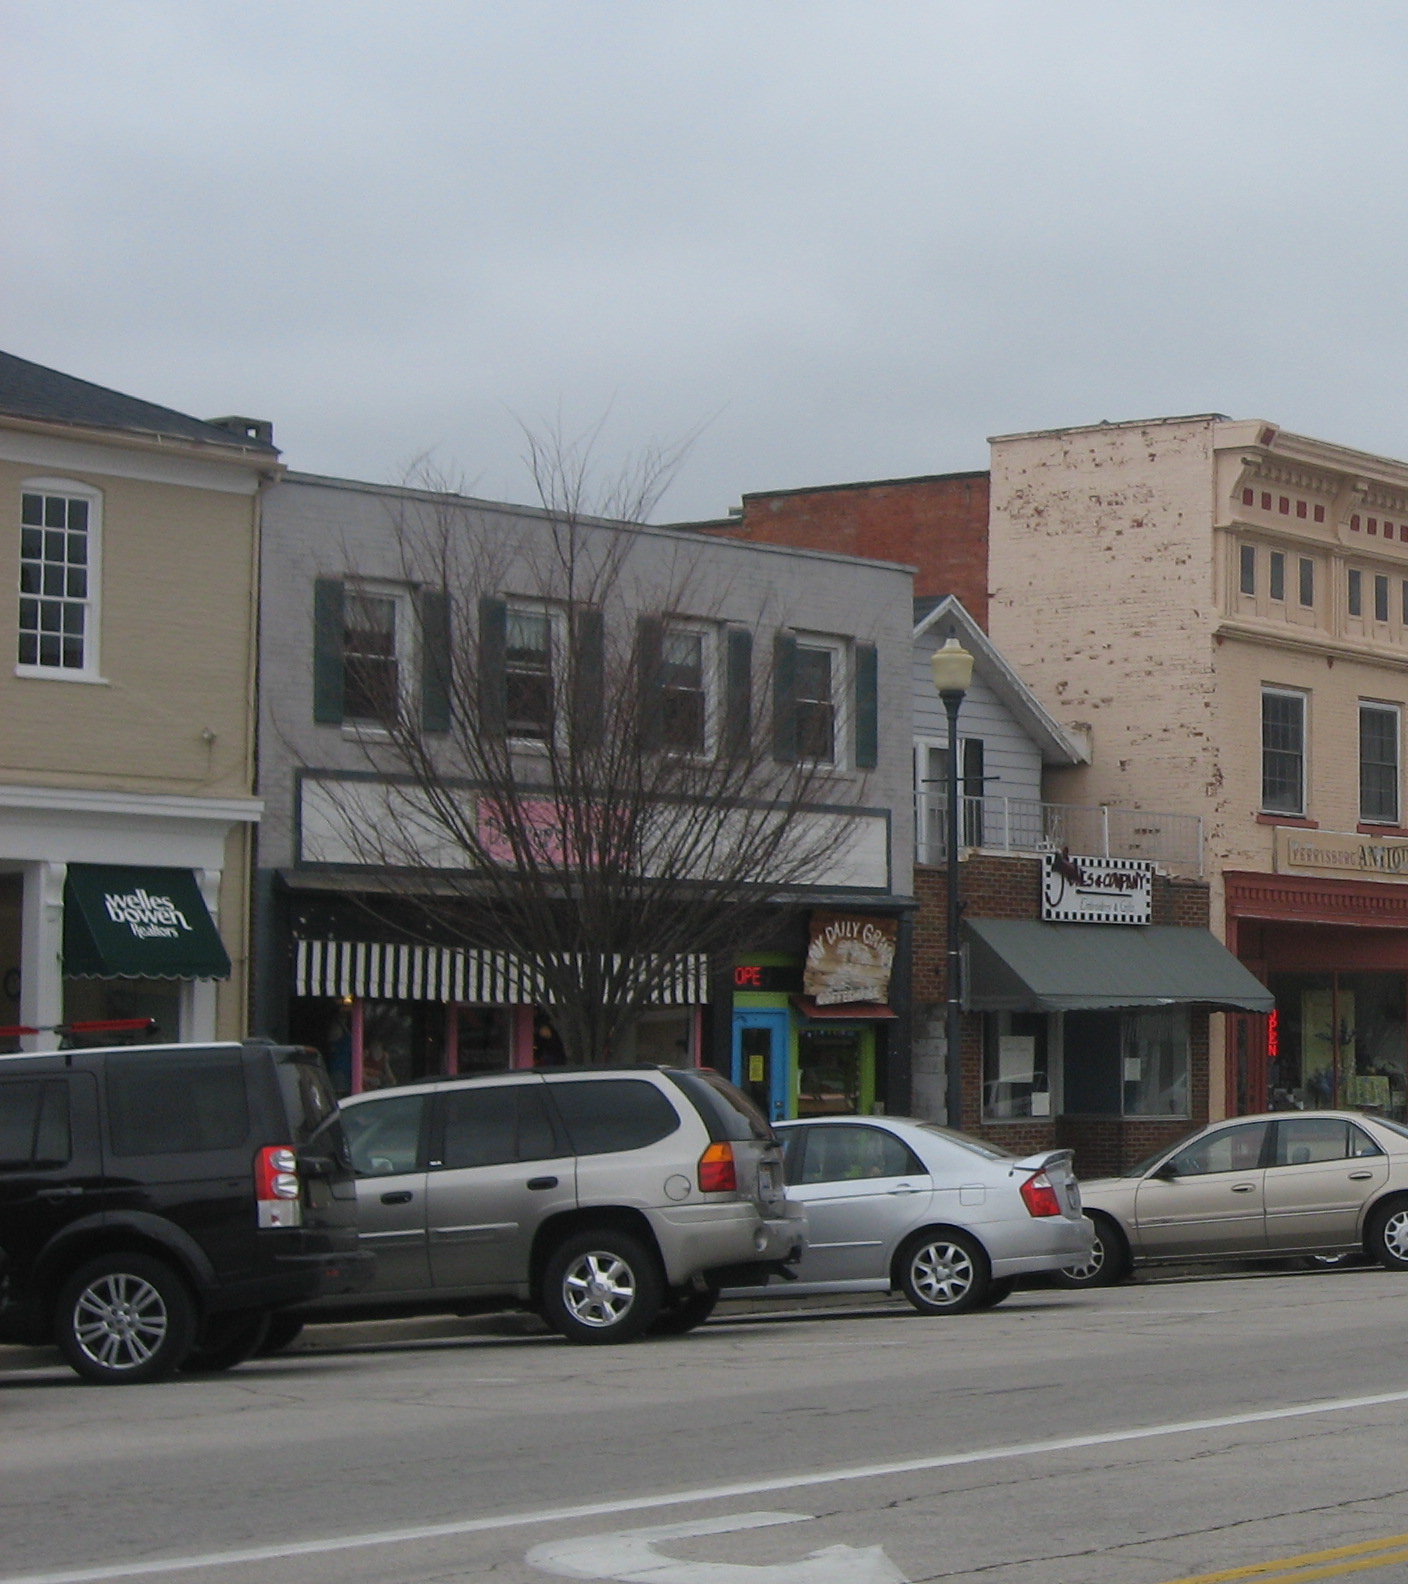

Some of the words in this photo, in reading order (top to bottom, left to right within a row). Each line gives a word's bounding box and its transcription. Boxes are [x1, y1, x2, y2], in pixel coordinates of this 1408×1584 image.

[1103, 871, 1146, 892] COMPANY
[104, 888, 175, 911] welles
[104, 899, 193, 931] bowen
[825, 921, 861, 946] DAILY
